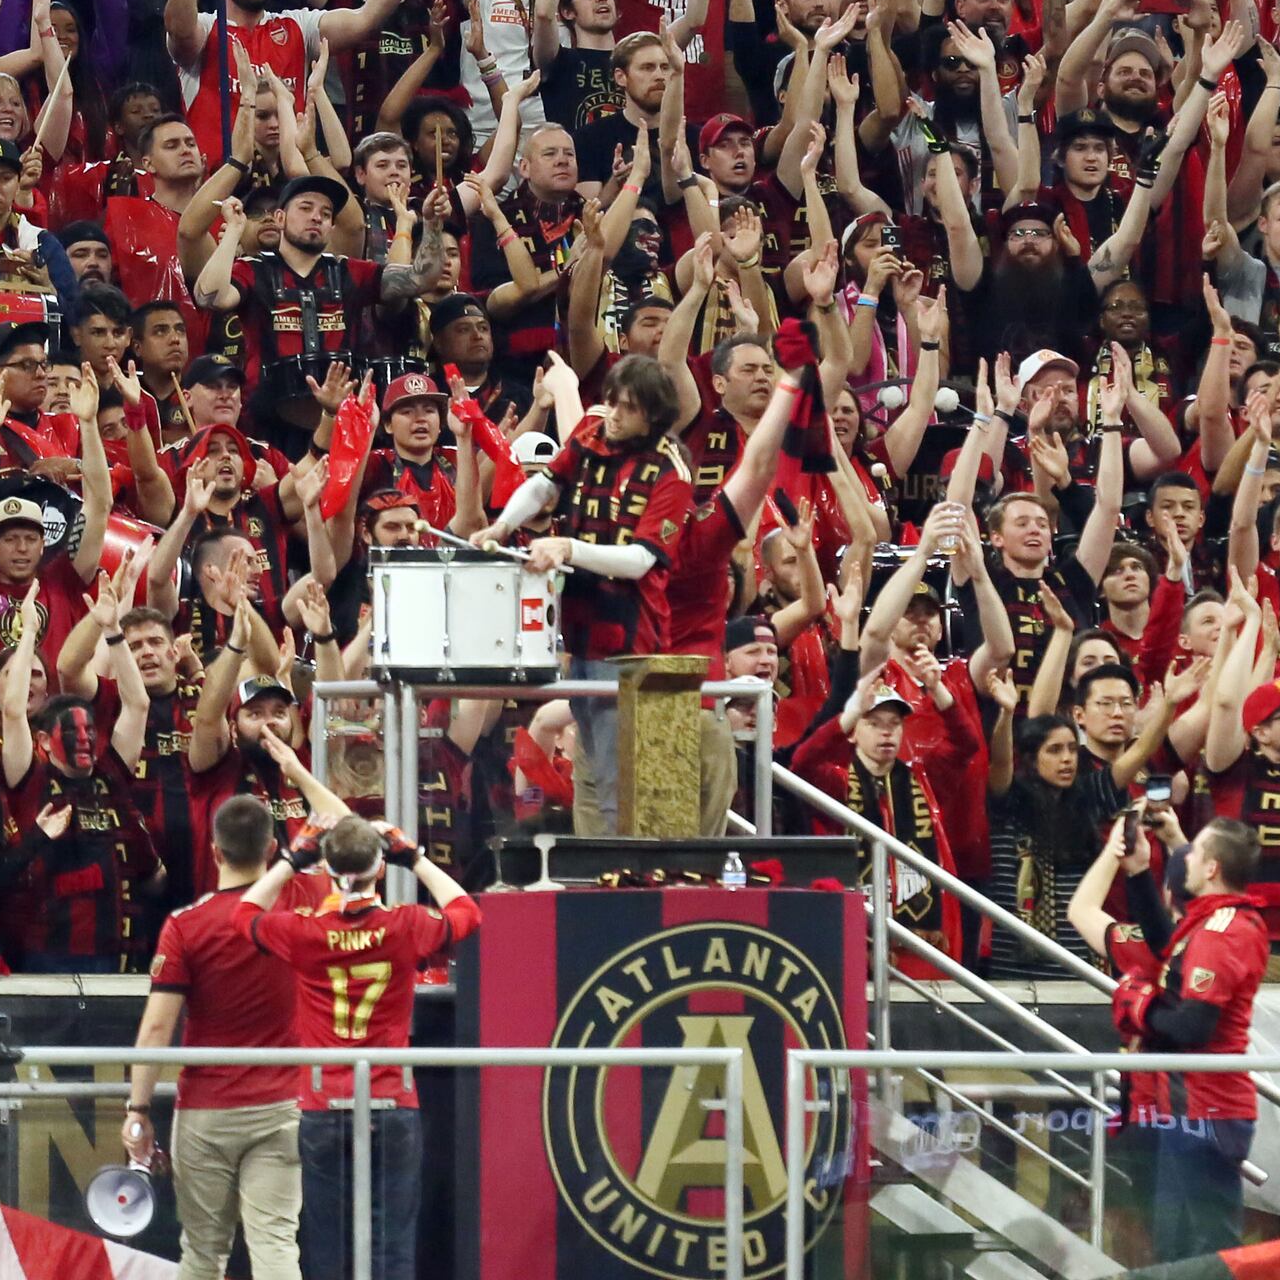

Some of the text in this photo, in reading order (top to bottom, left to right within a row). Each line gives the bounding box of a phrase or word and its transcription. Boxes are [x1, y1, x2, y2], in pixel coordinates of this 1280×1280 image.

[326, 926, 388, 952] PINKY
[595, 937, 822, 1024] ATLANTA
[326, 961, 393, 1041] 17
[582, 1176, 769, 1271] UNITED
